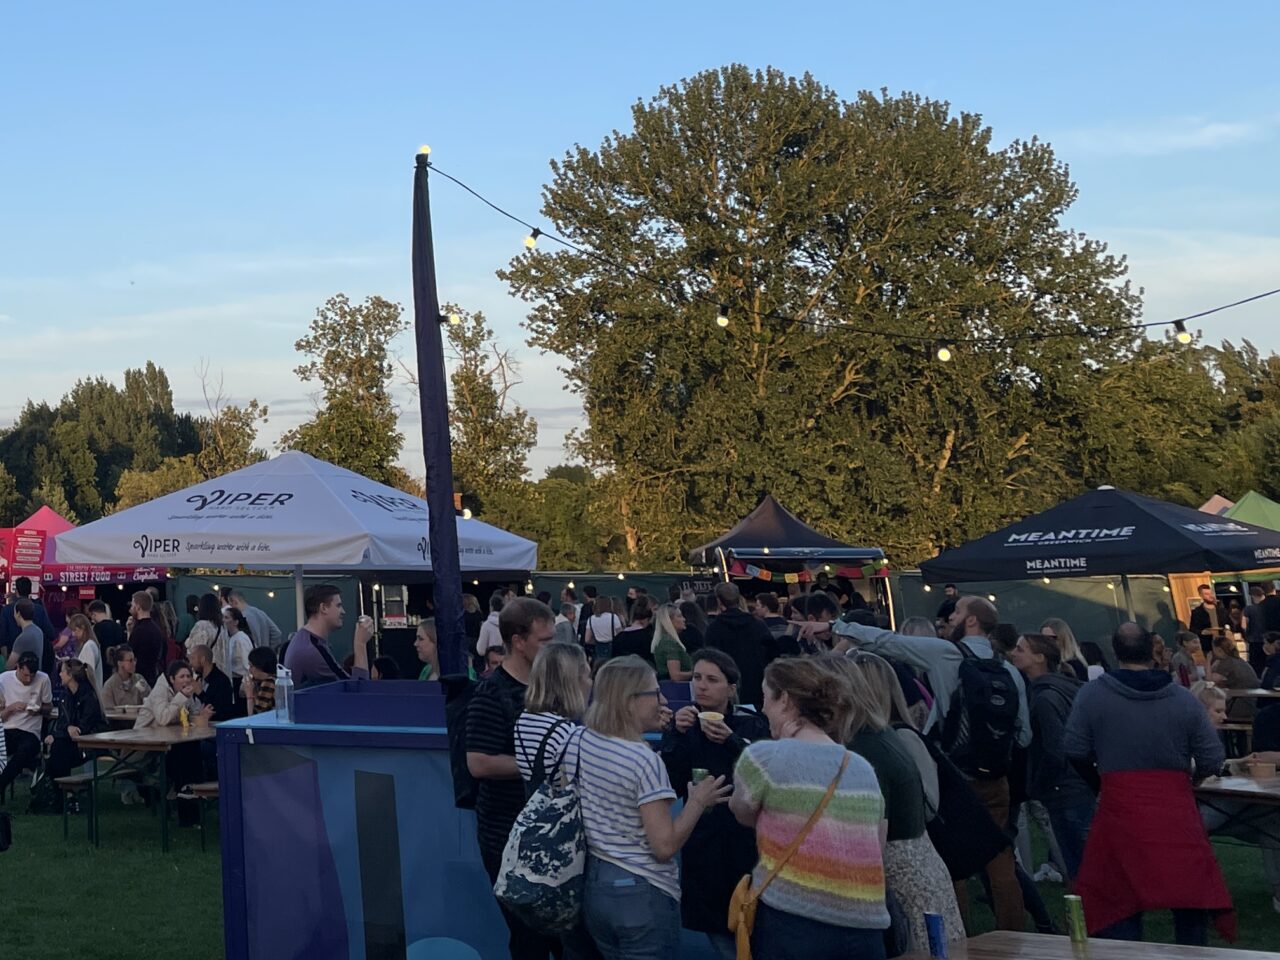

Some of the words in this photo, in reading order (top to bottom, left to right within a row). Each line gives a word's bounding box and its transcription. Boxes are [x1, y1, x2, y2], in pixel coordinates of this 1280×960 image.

[186, 489, 294, 511] VIPER
[1007, 526, 1137, 542] MEANTIME
[133, 534, 181, 558] VIPER
[1026, 557, 1087, 569] MEANTIME
[60, 571, 88, 583] STREET
[91, 571, 111, 582] FOOD
